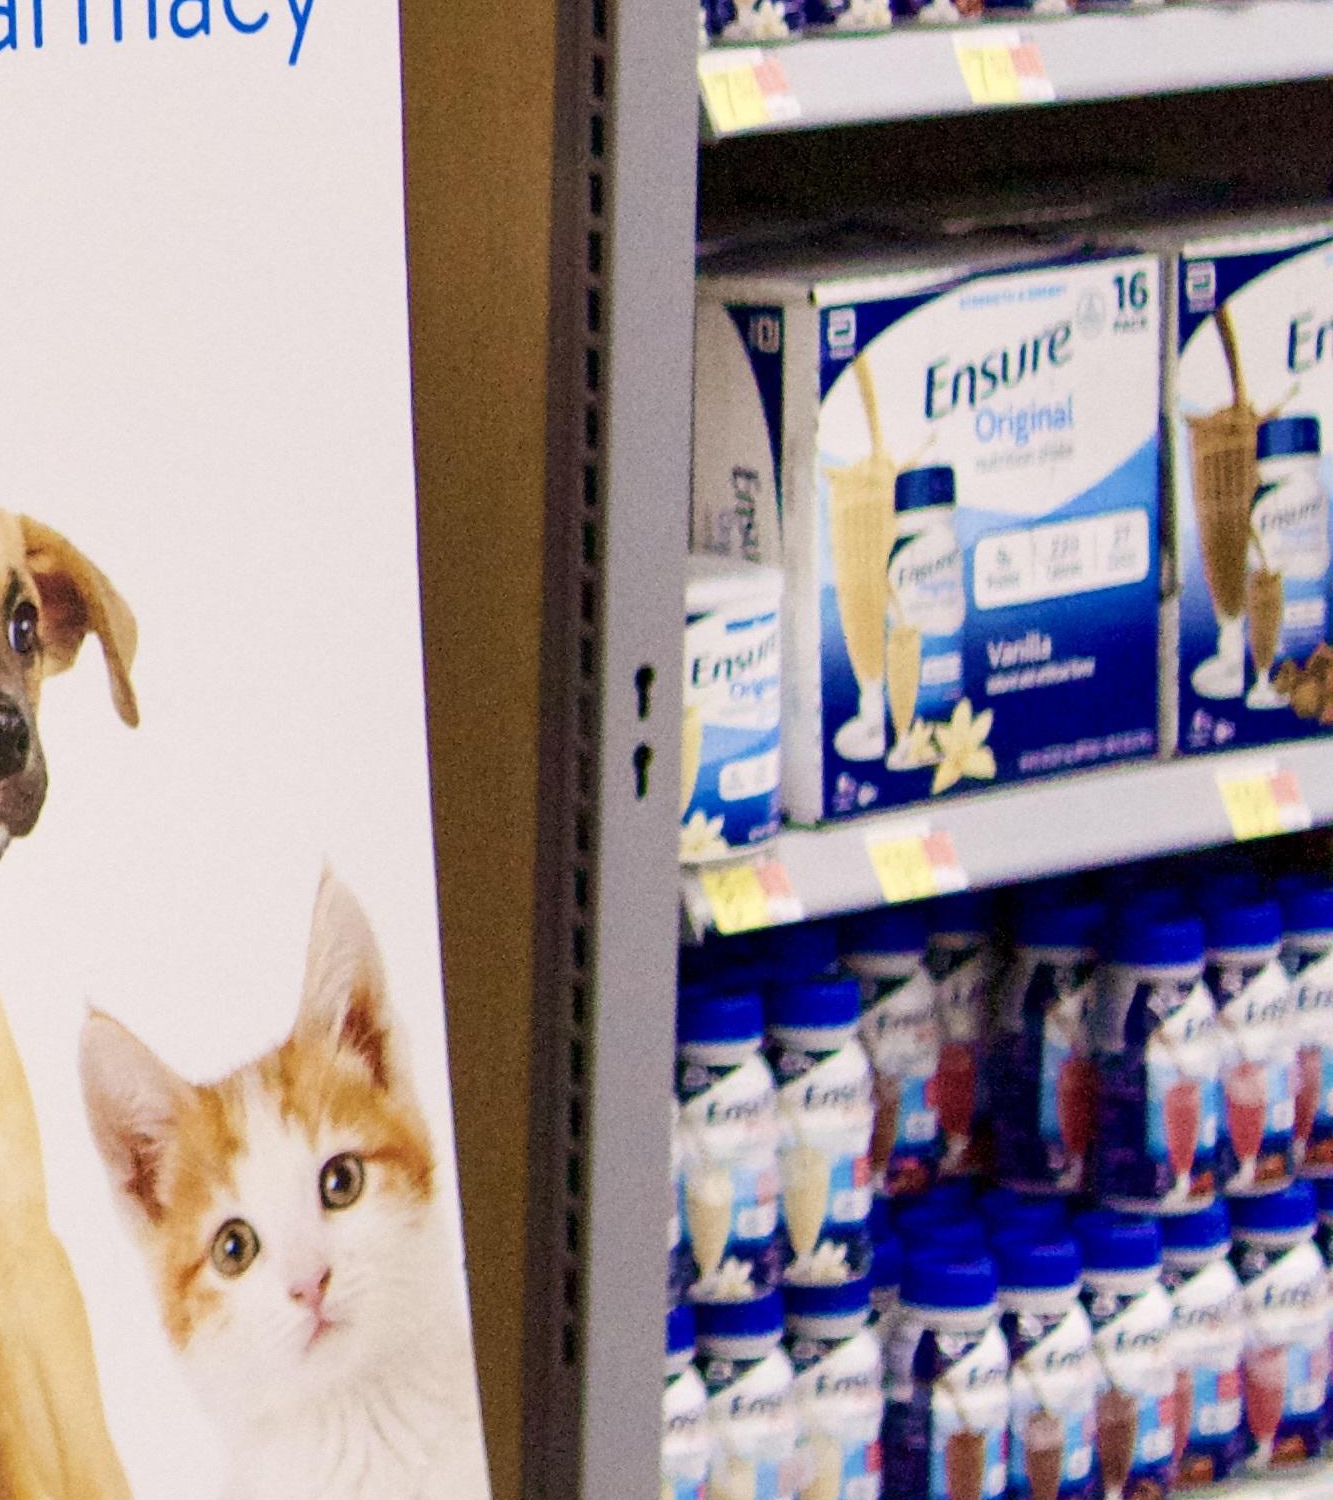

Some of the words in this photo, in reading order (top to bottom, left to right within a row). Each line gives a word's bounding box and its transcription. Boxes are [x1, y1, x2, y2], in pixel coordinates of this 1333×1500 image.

[1113, 271, 1149, 312] 16
[924, 319, 1073, 420] Ensure
[975, 394, 1074, 446] Original
[987, 631, 1052, 670] Vanilla
